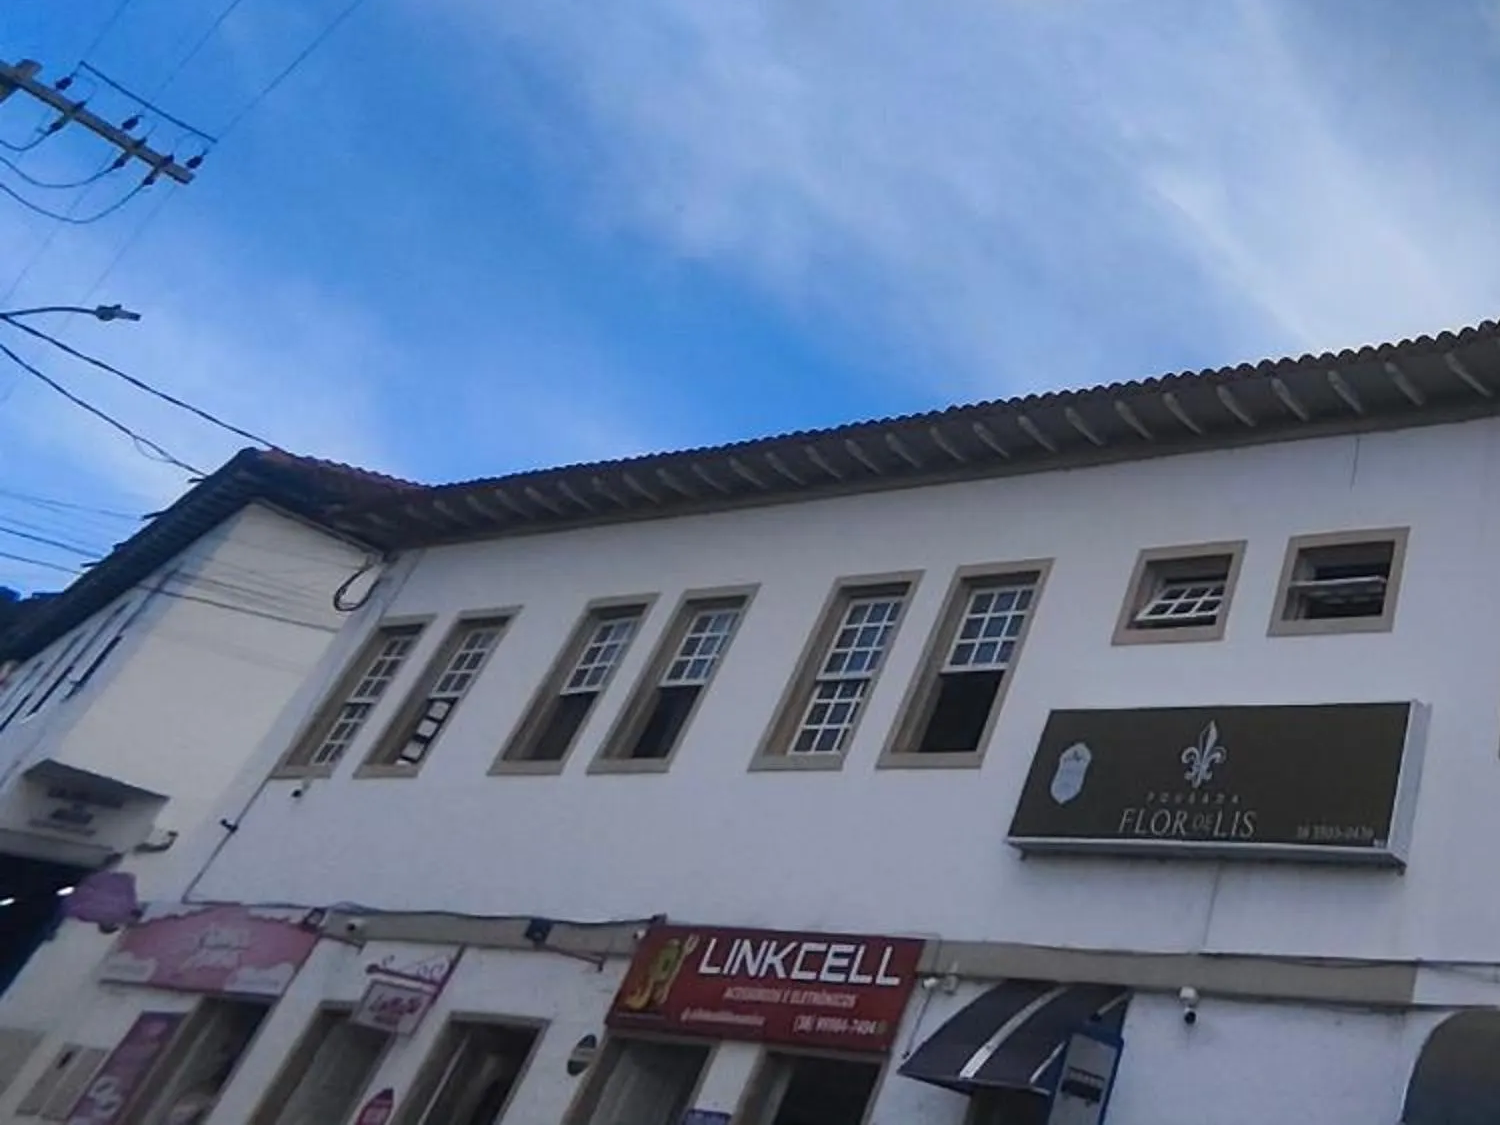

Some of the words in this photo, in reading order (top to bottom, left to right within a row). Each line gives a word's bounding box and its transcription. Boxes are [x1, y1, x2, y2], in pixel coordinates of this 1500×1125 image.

[1118, 808, 1187, 836] FLOR
[1212, 809, 1257, 838] LIS
[698, 937, 900, 986] LINKCELL
